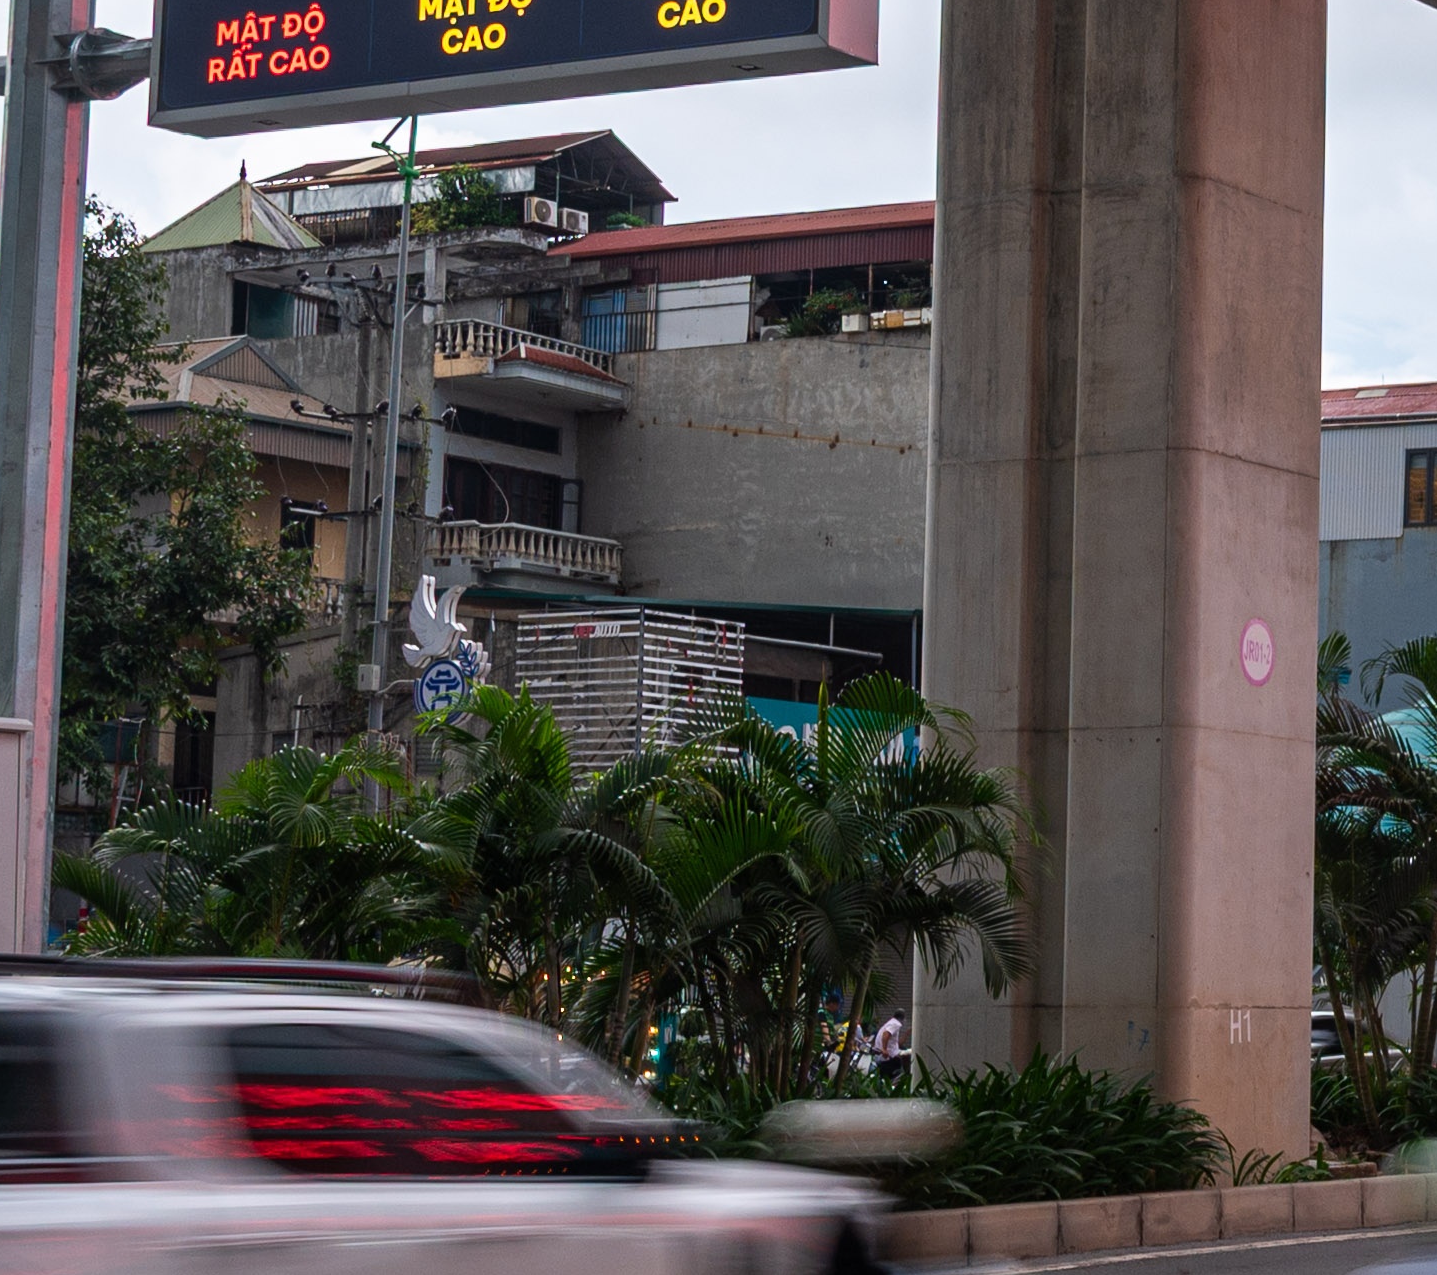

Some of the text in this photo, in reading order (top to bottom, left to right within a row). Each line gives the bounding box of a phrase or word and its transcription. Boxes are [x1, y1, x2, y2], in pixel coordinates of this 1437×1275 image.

[216, 2, 326, 47] MẬT ĐỘ
[440, 23, 508, 55] CAO
[207, 42, 331, 83] RẤT CAO
[1230, 1009, 1251, 1044] H1
